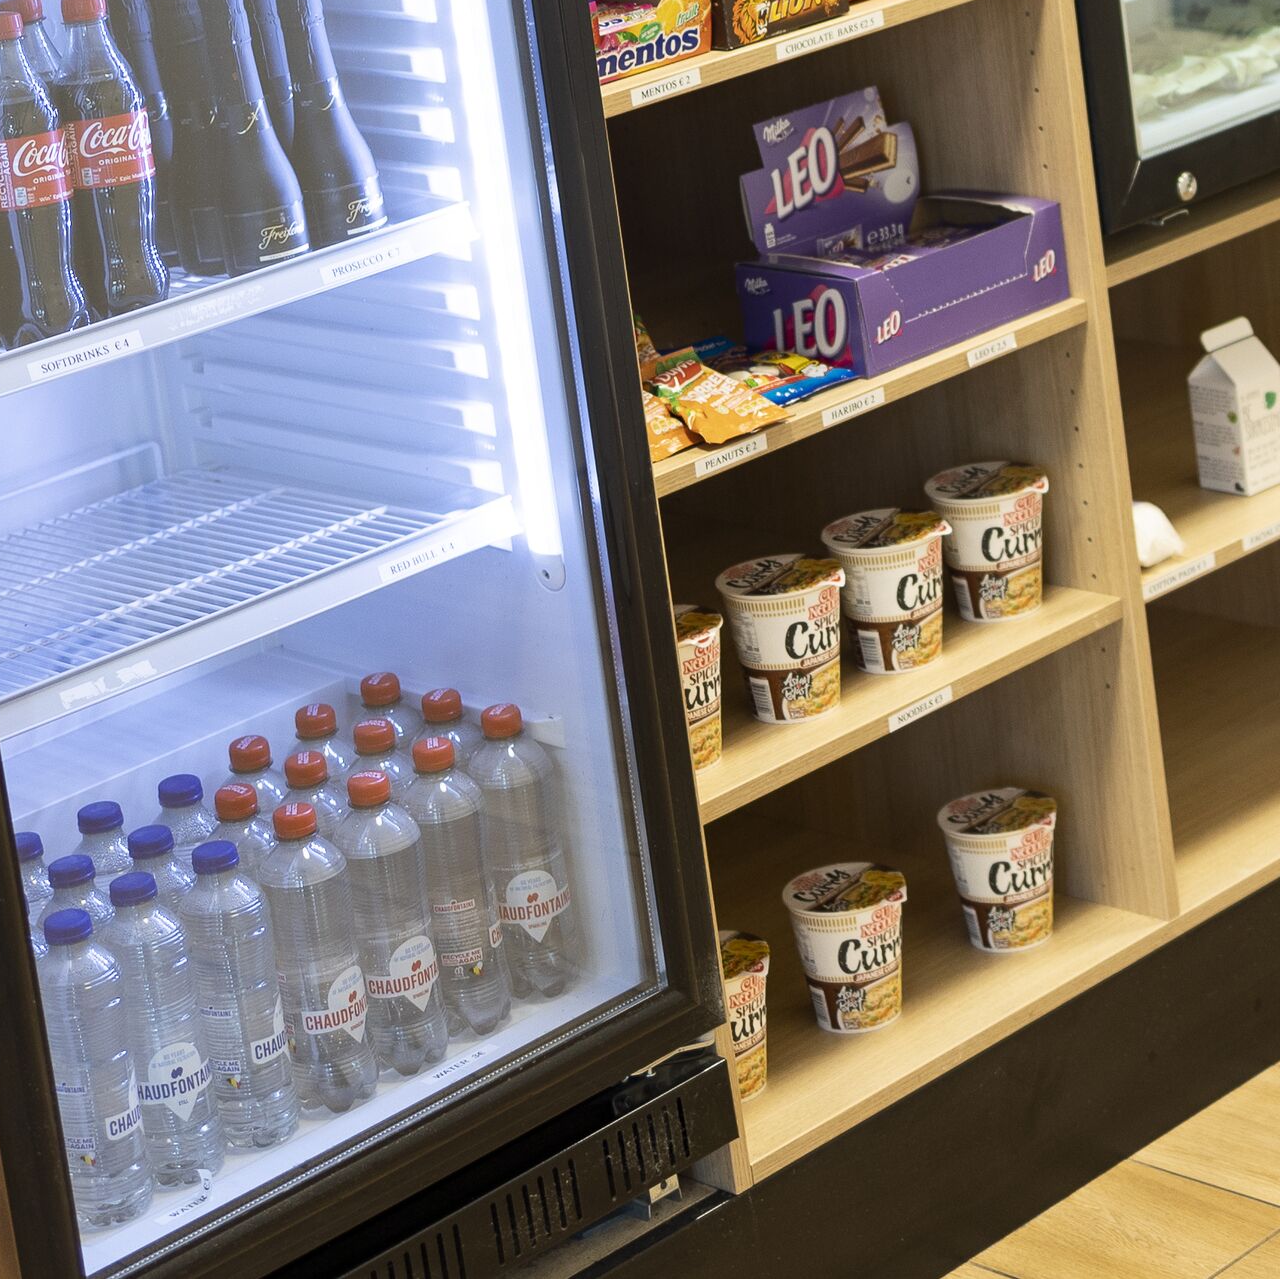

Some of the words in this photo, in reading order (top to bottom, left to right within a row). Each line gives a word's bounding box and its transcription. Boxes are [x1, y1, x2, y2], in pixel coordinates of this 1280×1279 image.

[676, 2, 700, 27] fruit
[785, 30, 834, 55] CHOCOLATE
[837, 23, 860, 39] BARS
[641, 80, 678, 100] MENTOS
[763, 117, 791, 143] Milka
[0, 142, 11, 175] AGAIN
[98, 155, 137, 166] ORIGINAL
[771, 126, 837, 220] LEO
[331, 251, 384, 278] PROSECCO
[1033, 249, 1056, 282] LEO
[773, 288, 847, 358] LEO
[877, 310, 901, 345] LEO
[40, 344, 110, 374] SOFTDRINKS
[123, 338, 130, 348] 4
[974, 347, 990, 361] LEO
[831, 399, 864, 419] HARIBO
[704, 446, 745, 470] PEANUTS
[981, 526, 1042, 562] Curr
[389, 559, 411, 575] RED
[411, 549, 437, 566] BULL
[1148, 576, 1177, 594] COTTON
[785, 621, 840, 659] Curr
[896, 701, 934, 725] NOODELS
[793, 869, 850, 903] Curry
[989, 861, 1051, 895] Curr
[434, 900, 475, 913] CHAUDFONTAINE
[442, 951, 469, 961] RECYCLE
[470, 949, 482, 957] ME
[458, 954, 482, 964] AGAIN
[838, 938, 901, 975] Curr
[368, 961, 438, 996] CHAUDFONTA
[432, 1059, 470, 1079] WATER
[168, 1194, 208, 1218] WATER
